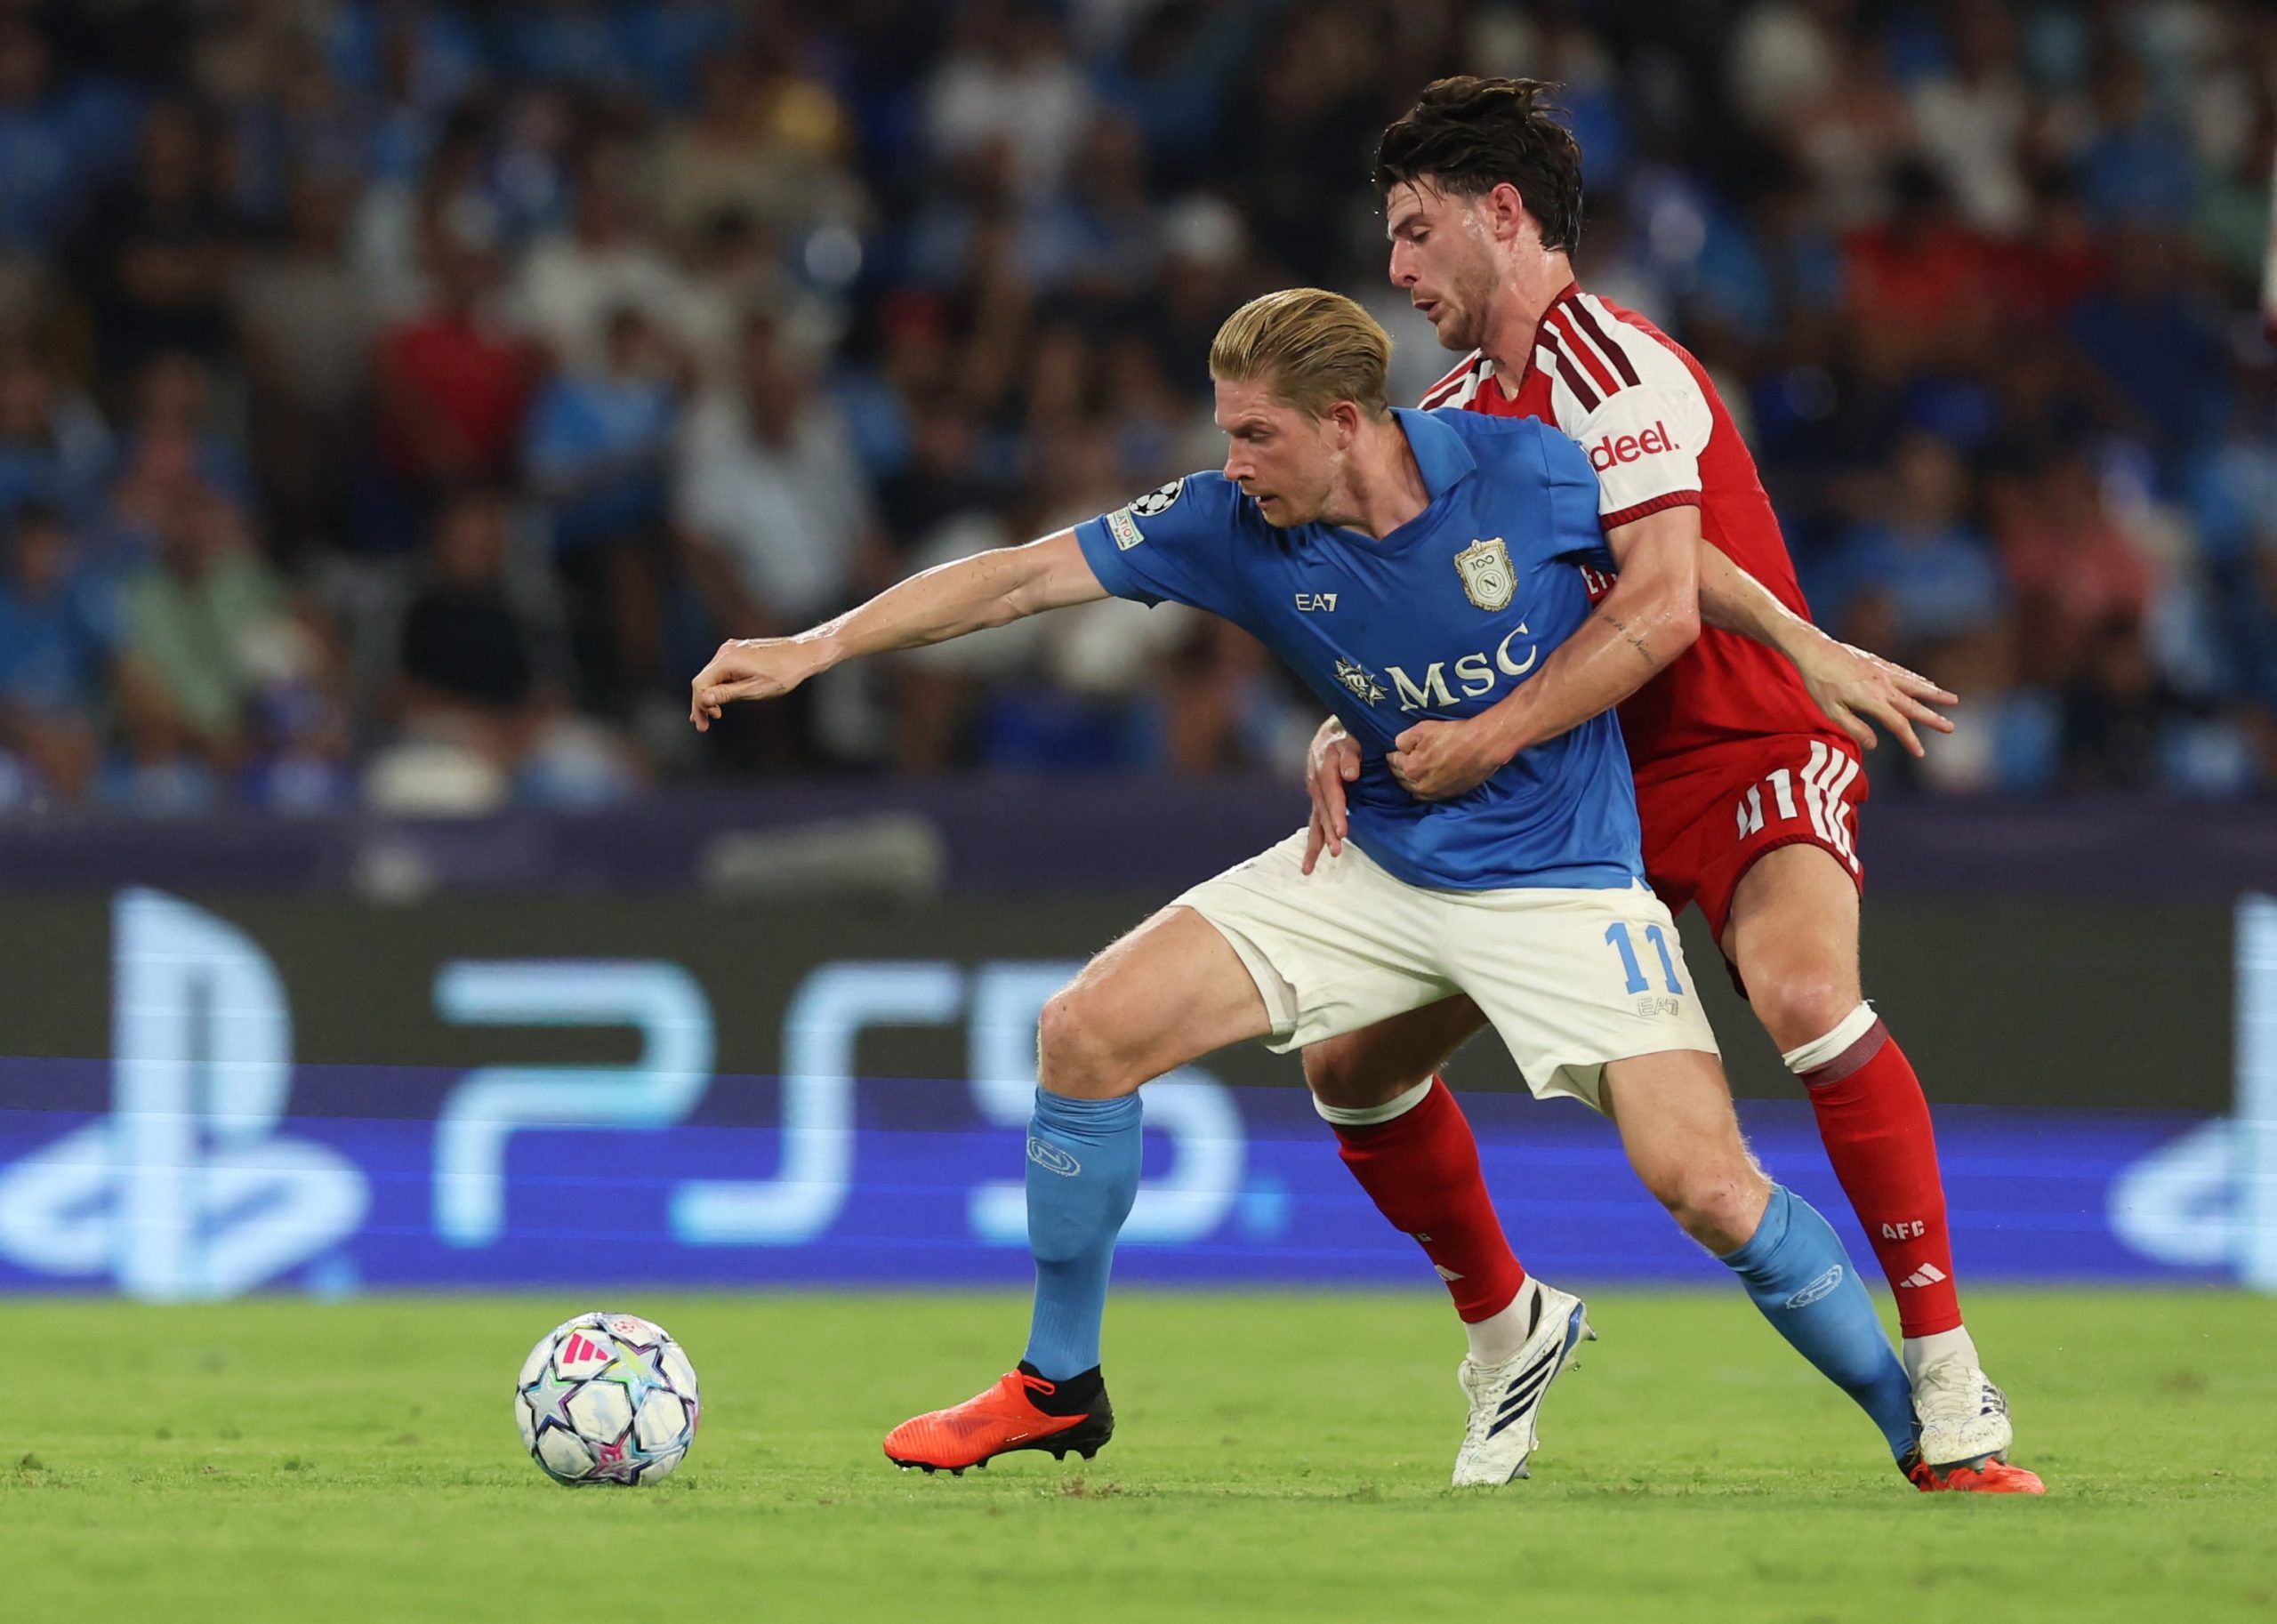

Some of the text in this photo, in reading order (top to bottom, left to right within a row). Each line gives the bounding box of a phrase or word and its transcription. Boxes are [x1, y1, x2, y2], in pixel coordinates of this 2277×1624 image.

[1589, 420, 1680, 472] deel.
[1295, 593, 1338, 612] EA7
[1385, 623, 1536, 712] MSC
[1605, 922, 1684, 995] 11
[1637, 997, 1679, 1017] EA7
[432, 959, 1246, 1245] PS5
[1881, 1219, 1925, 1240] AFC
